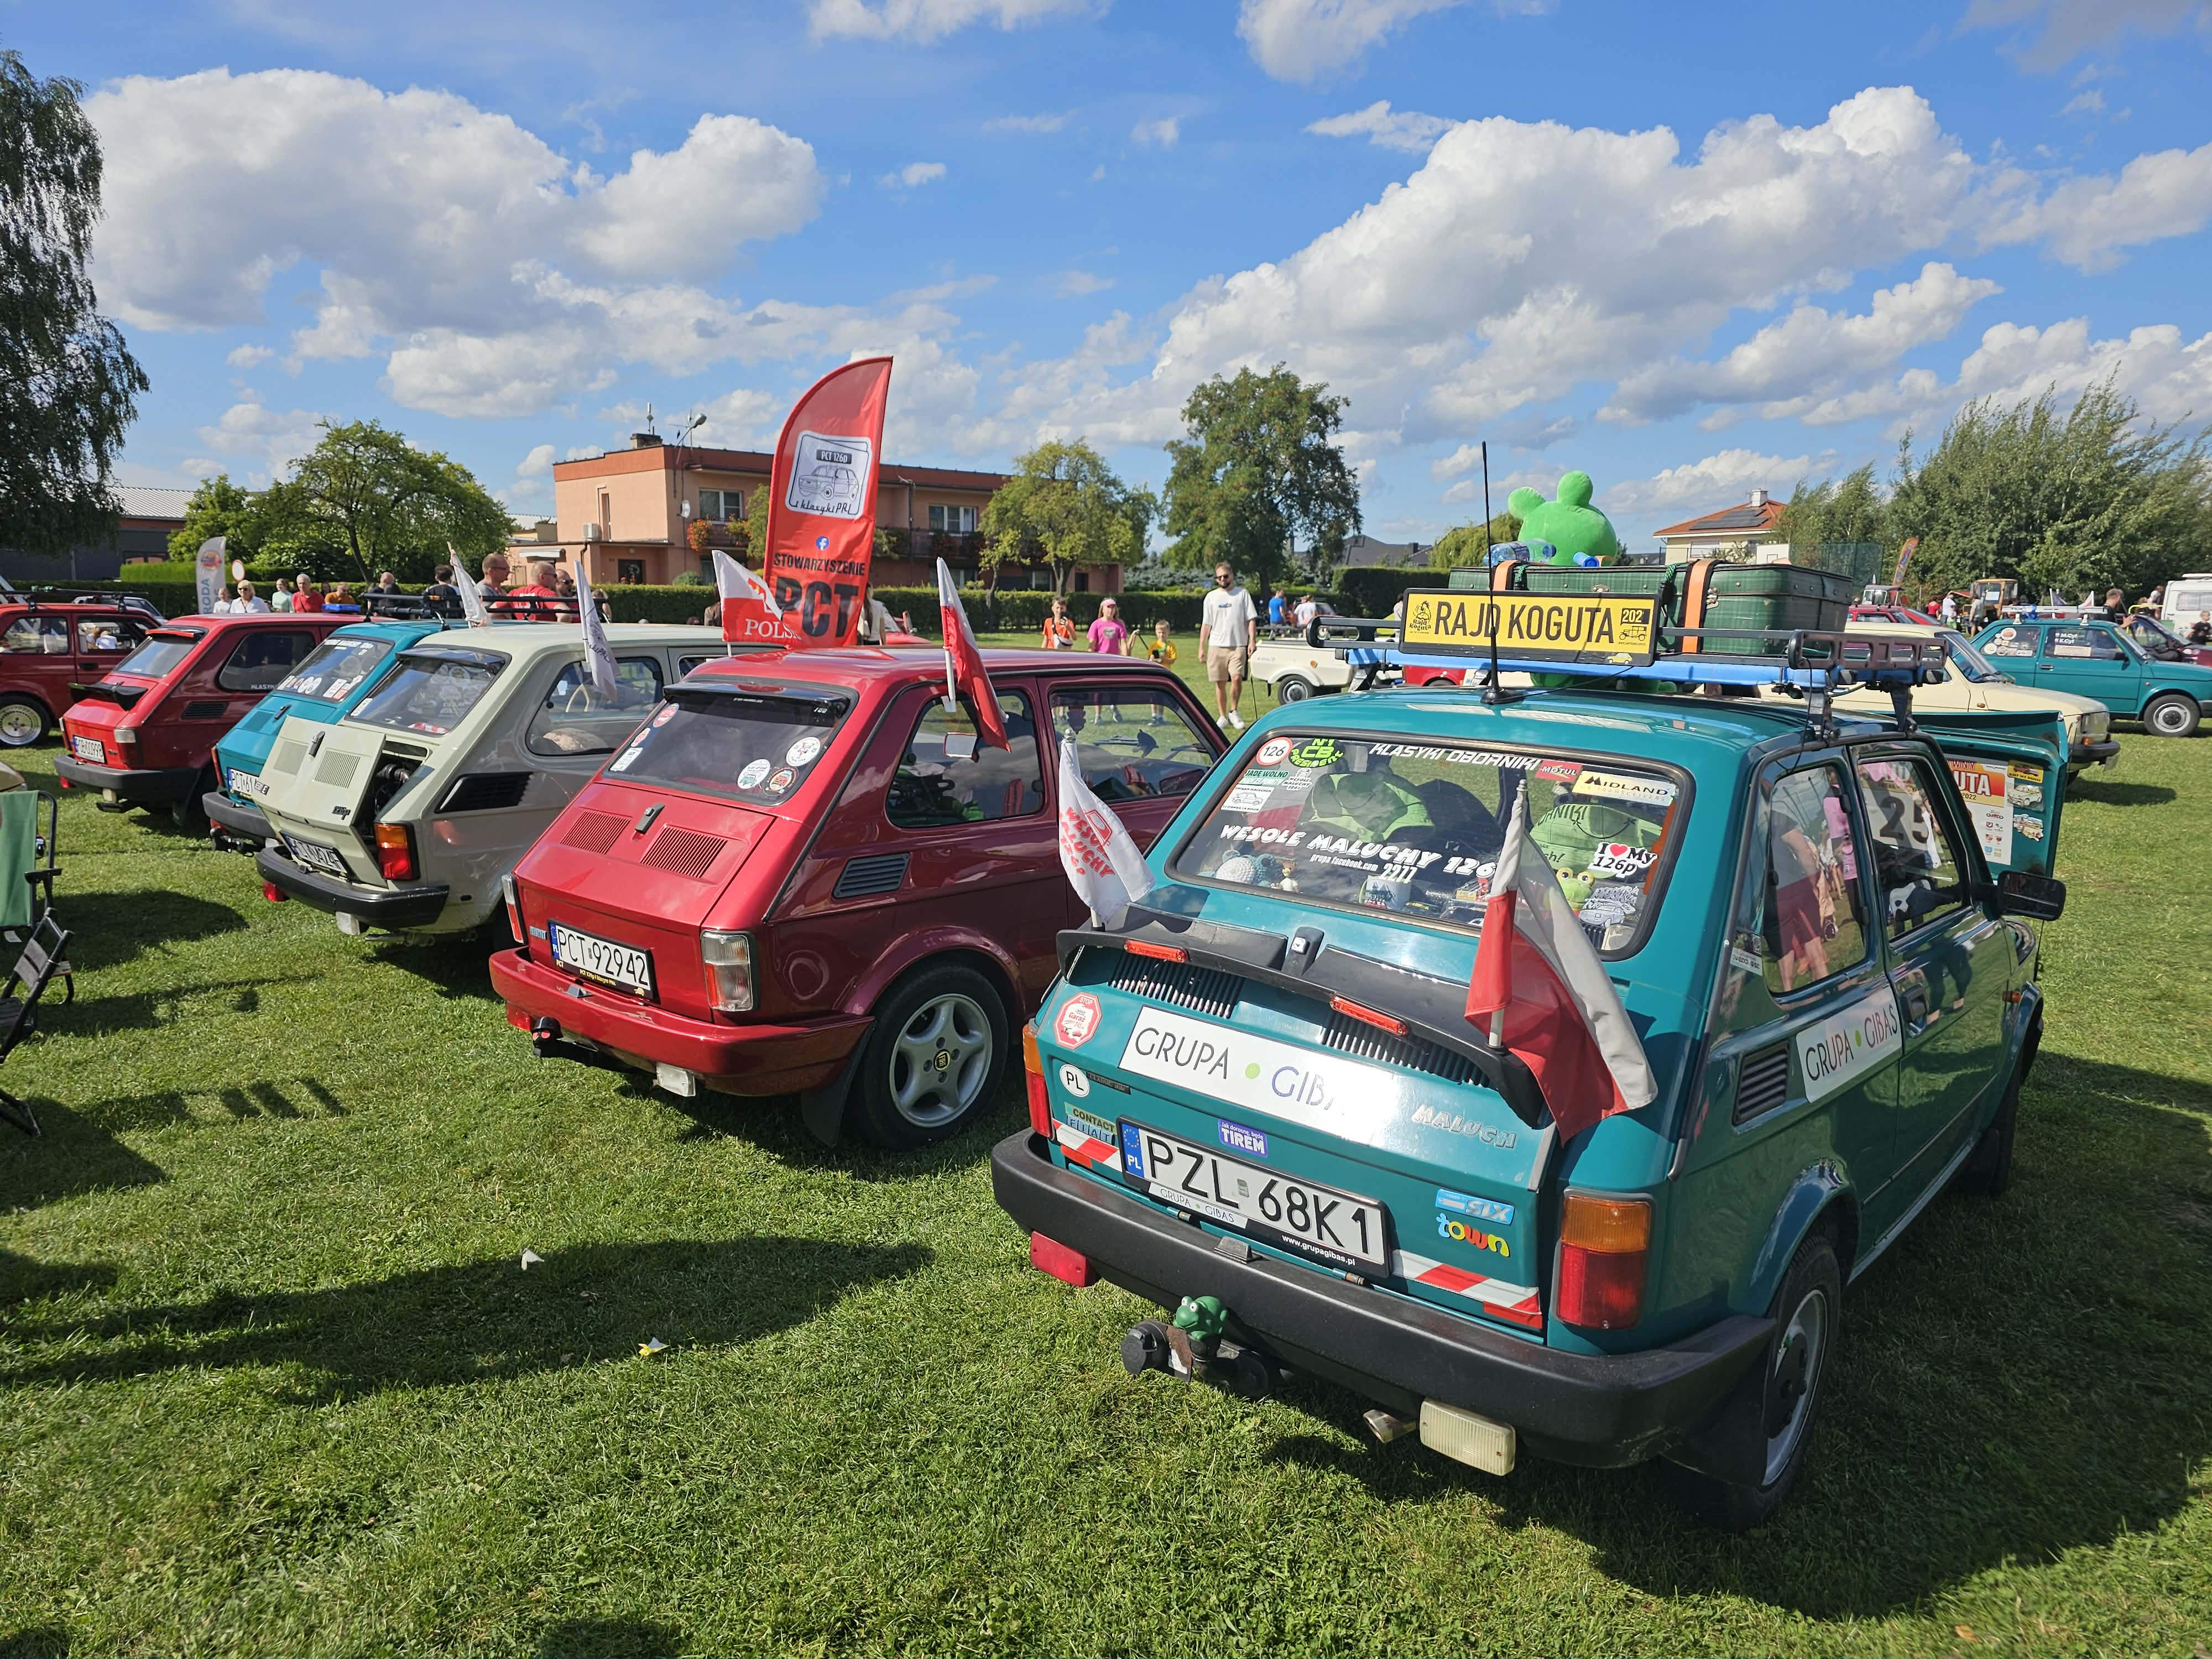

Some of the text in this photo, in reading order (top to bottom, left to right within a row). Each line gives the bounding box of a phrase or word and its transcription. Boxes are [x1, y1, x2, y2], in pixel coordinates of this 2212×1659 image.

[821, 451, 832, 461] PCT
[774, 552, 865, 576] STOWARZYSZENIE
[201, 578, 212, 614] RODA
[775, 576, 859, 638] PCT
[1434, 601, 1614, 644] RAJD KOGUTA
[1622, 609, 1645, 623] 202
[1263, 746, 1286, 757] 126
[1301, 745, 1334, 758] CB
[1369, 743, 1542, 770] KLASYKI OBORNIKI
[1541, 765, 1578, 775] MOTUL
[1584, 775, 1668, 796] MIDLAND
[1597, 787, 1665, 801] TRANSCEIVERS
[1953, 770, 1991, 796] UTA
[1220, 825, 1498, 878] WESOŁE MALUCHY 126
[1310, 853, 1379, 872] grupa facebook.com
[1598, 843, 1658, 864] I My
[1592, 855, 1637, 874] 126p
[557, 928, 649, 986] PCT 92942
[1079, 997, 1093, 1005] STOP
[1806, 1003, 1898, 1081] GRUPA GIBAS
[1066, 1070, 1084, 1092] PL
[1135, 1027, 1335, 1111] GRUPA GIB
[1069, 1118, 1110, 1143] FIAT
[1073, 1108, 1115, 1133] CONTACT
[1411, 1105, 1517, 1149] MALUCH
[1221, 1127, 1265, 1155] TIREM
[1127, 1154, 1142, 1171] PL
[1146, 1135, 1370, 1255] PZL 68K1
[1160, 1187, 1235, 1224] GRUPA GIBAS
[1436, 1212, 1510, 1258] town
[1281, 1233, 1356, 1267] www.grupagibas.pl
